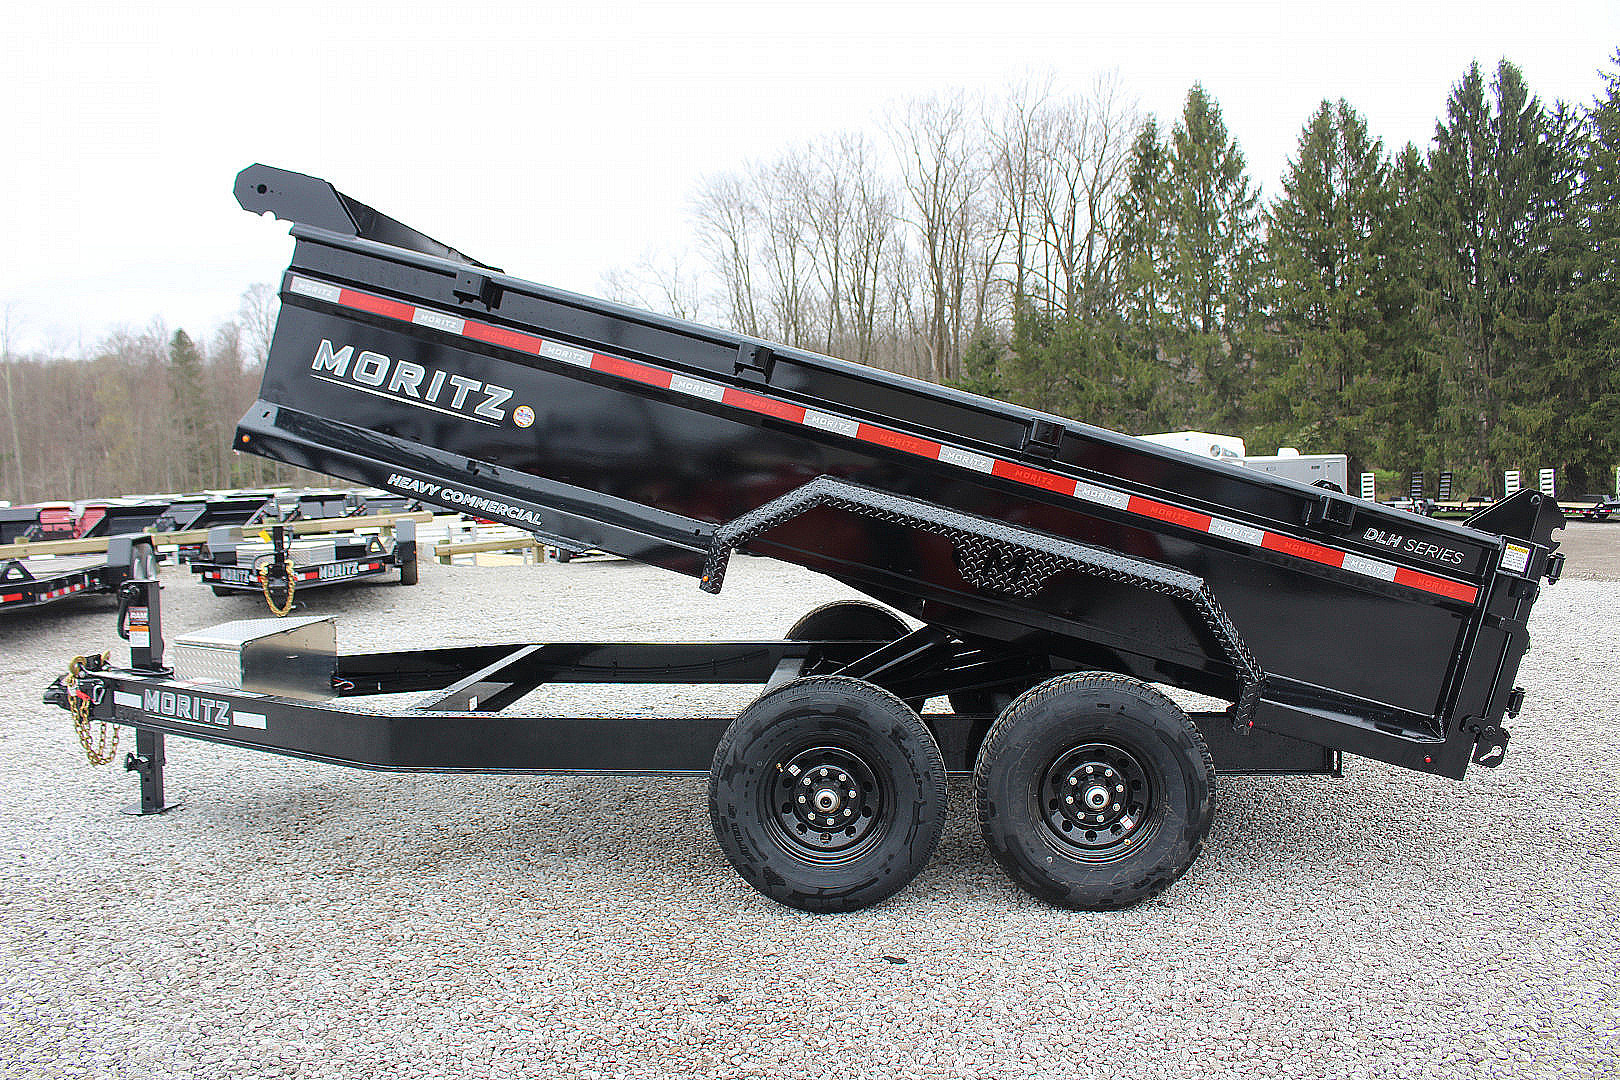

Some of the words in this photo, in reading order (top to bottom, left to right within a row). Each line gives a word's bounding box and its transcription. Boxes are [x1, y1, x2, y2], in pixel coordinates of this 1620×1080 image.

[420, 313, 457, 329] MORITZ
[548, 346, 586, 362] MORITZ
[311, 338, 514, 421] MORITZ
[676, 380, 717, 396] MORITZ
[811, 415, 852, 431] MORITZ
[946, 450, 987, 467] MORITZ
[1014, 469, 1054, 486] MORITZ
[386, 473, 441, 496] HEAVY
[440, 488, 542, 526] COMMERCIAL
[1081, 487, 1123, 503] MORITZ
[1149, 505, 1190, 522] MORITZ
[1217, 523, 1259, 540] MORITZ
[1284, 541, 1324, 558] MORITZ
[1363, 527, 1402, 548] DLH
[1403, 539, 1465, 565] SERIES
[318, 562, 359, 580] MORITZ
[1349, 559, 1391, 577] MORITZ
[143, 689, 232, 726] MORITZ
